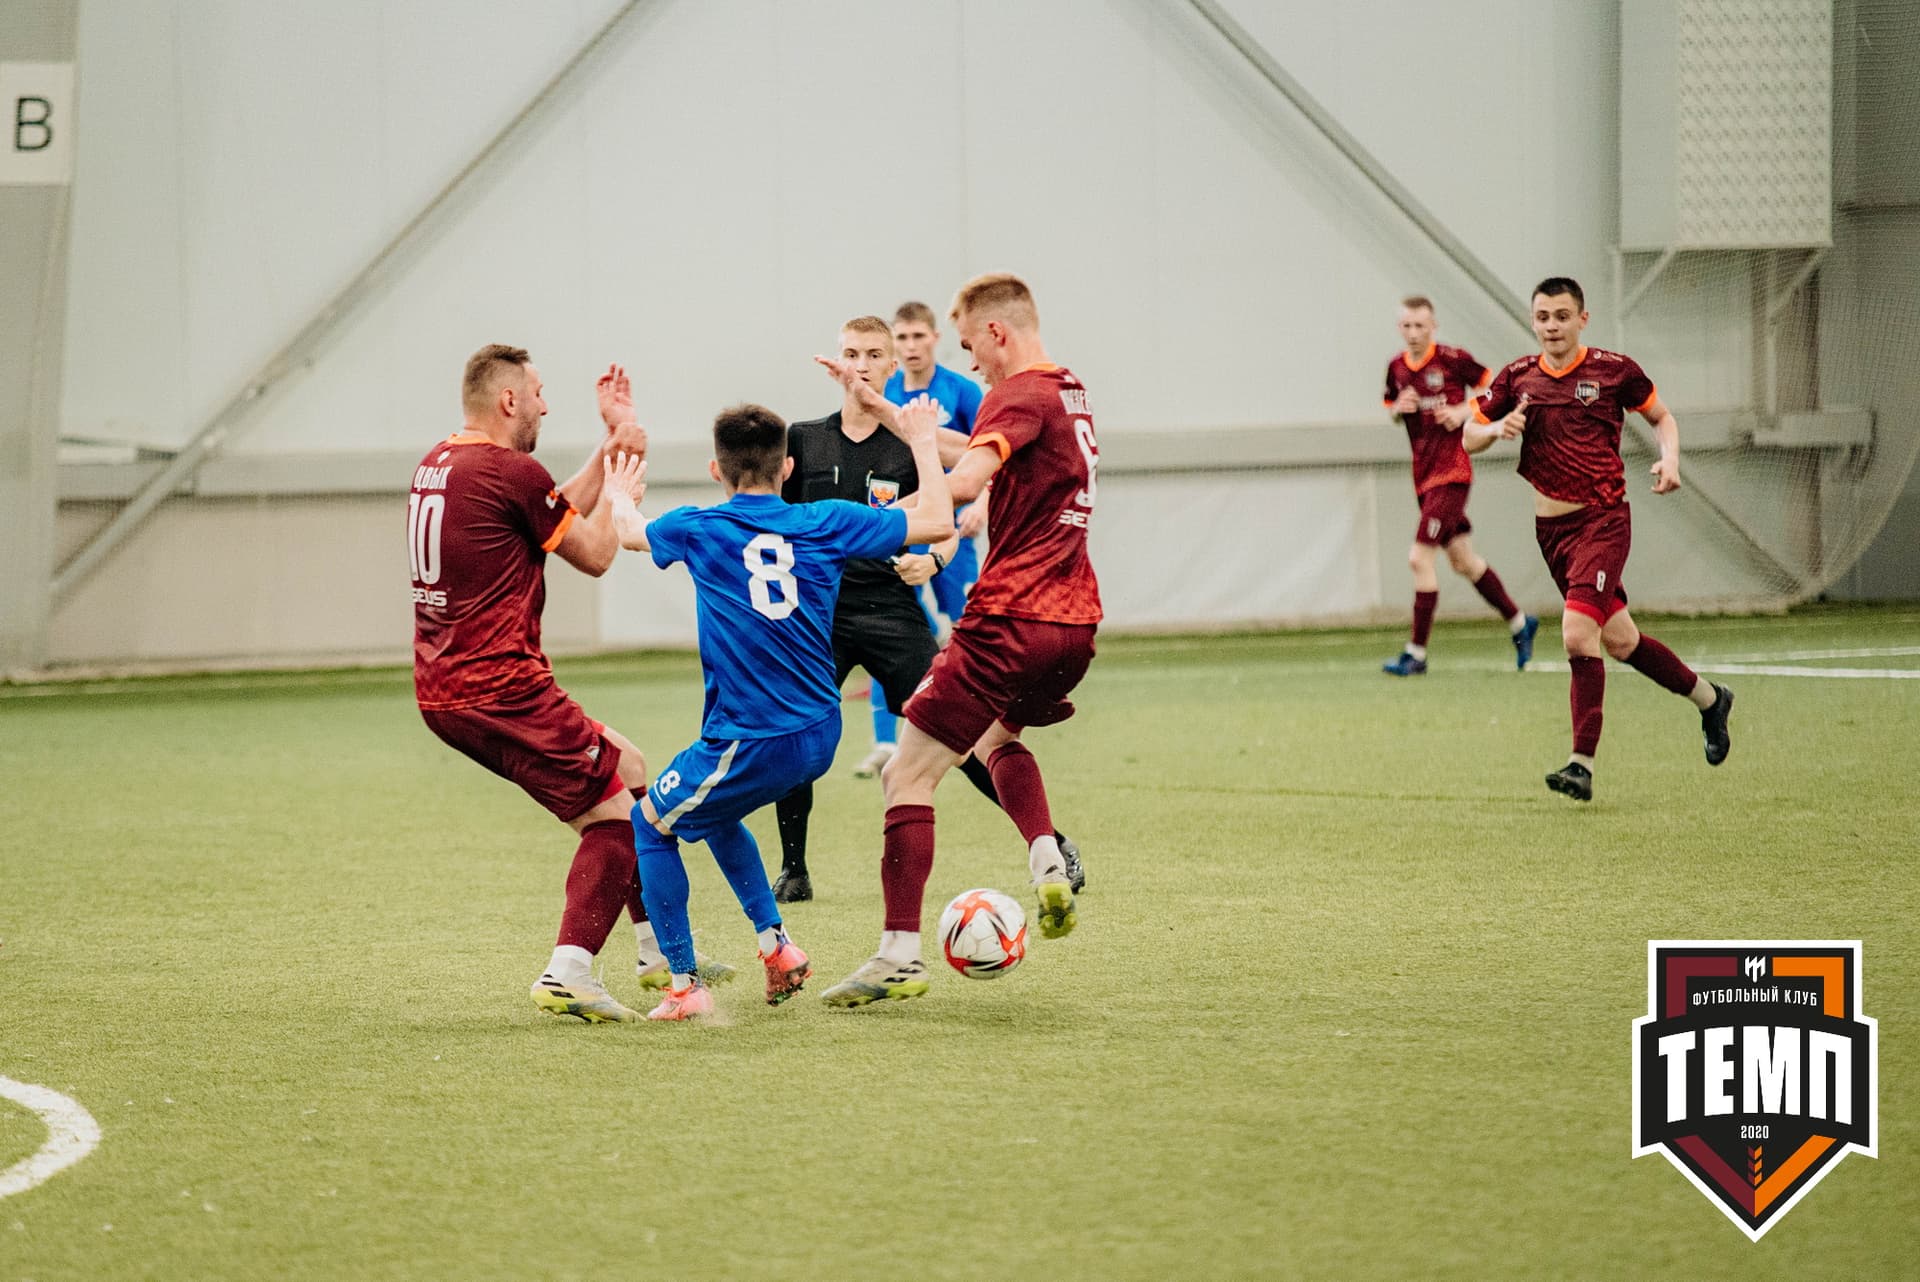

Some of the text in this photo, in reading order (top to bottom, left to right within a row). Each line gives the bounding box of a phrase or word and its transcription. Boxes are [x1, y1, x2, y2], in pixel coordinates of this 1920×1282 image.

[16, 97, 53, 150] B
[407, 493, 446, 585] 10
[742, 533, 799, 620] 8
[1596, 570, 1606, 593] 8
[660, 769, 681, 796] 8
